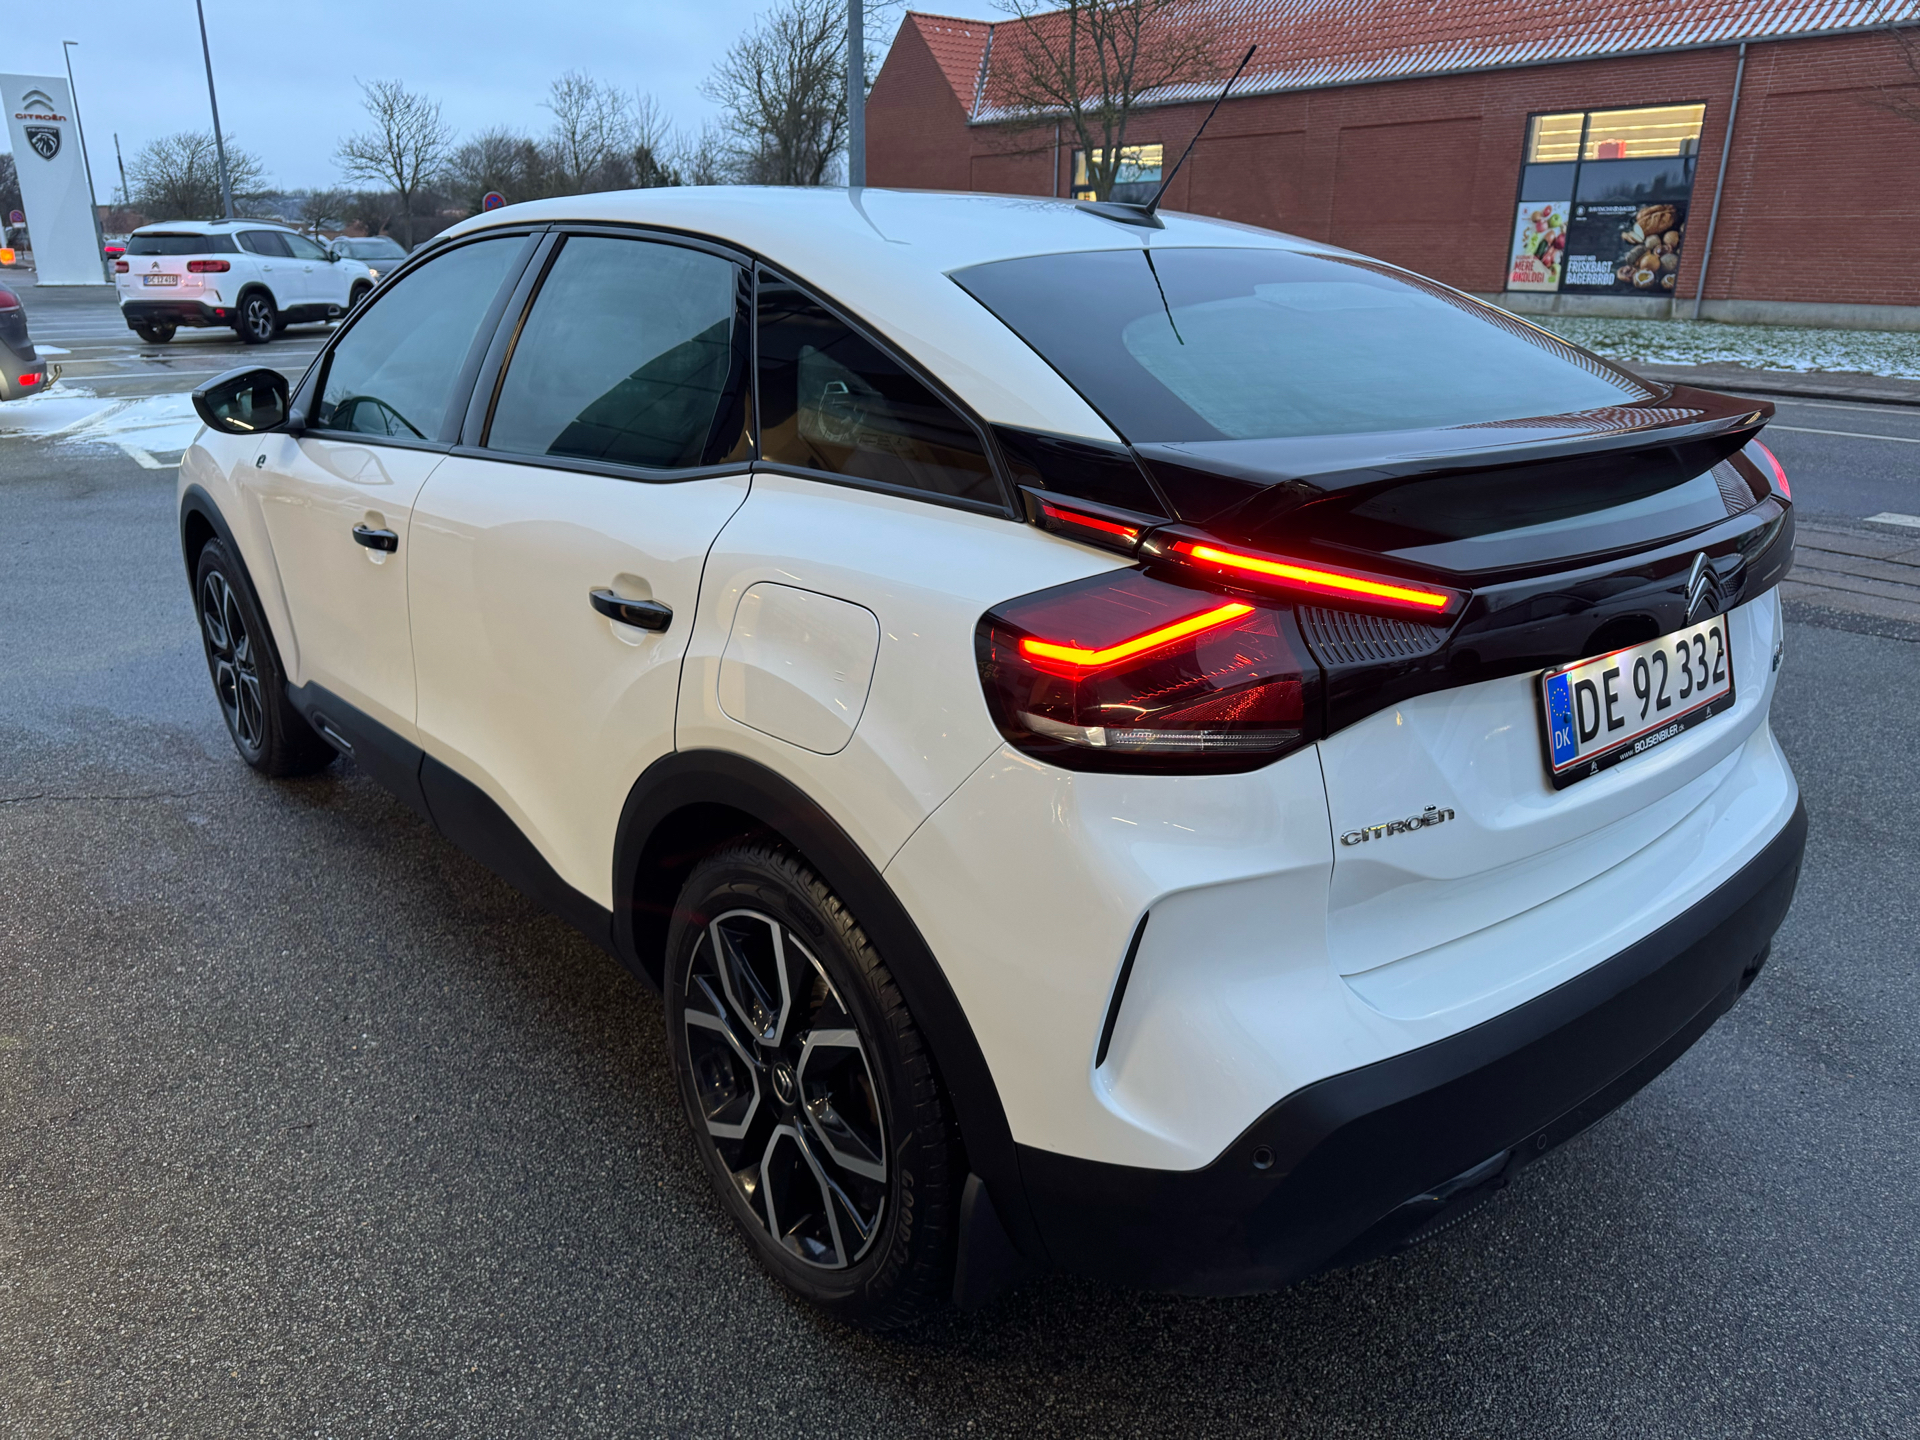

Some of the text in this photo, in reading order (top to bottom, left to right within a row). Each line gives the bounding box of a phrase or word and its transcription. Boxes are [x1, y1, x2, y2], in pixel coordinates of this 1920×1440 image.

[15, 113, 67, 121] CITROËN
[1514, 260, 1535, 271] MERE
[1567, 261, 1613, 273] FRISKBAGT
[1512, 271, 1545, 283] ØKOLOGI
[1565, 273, 1615, 285] BAGERBRØD
[1574, 666, 1625, 744] DE
[1632, 649, 1671, 721] 92
[1675, 626, 1726, 699] 332
[1554, 726, 1571, 749] DK
[1619, 723, 1685, 760] www.BOJSENBILER.dk
[1340, 804, 1455, 846] CITROËN
